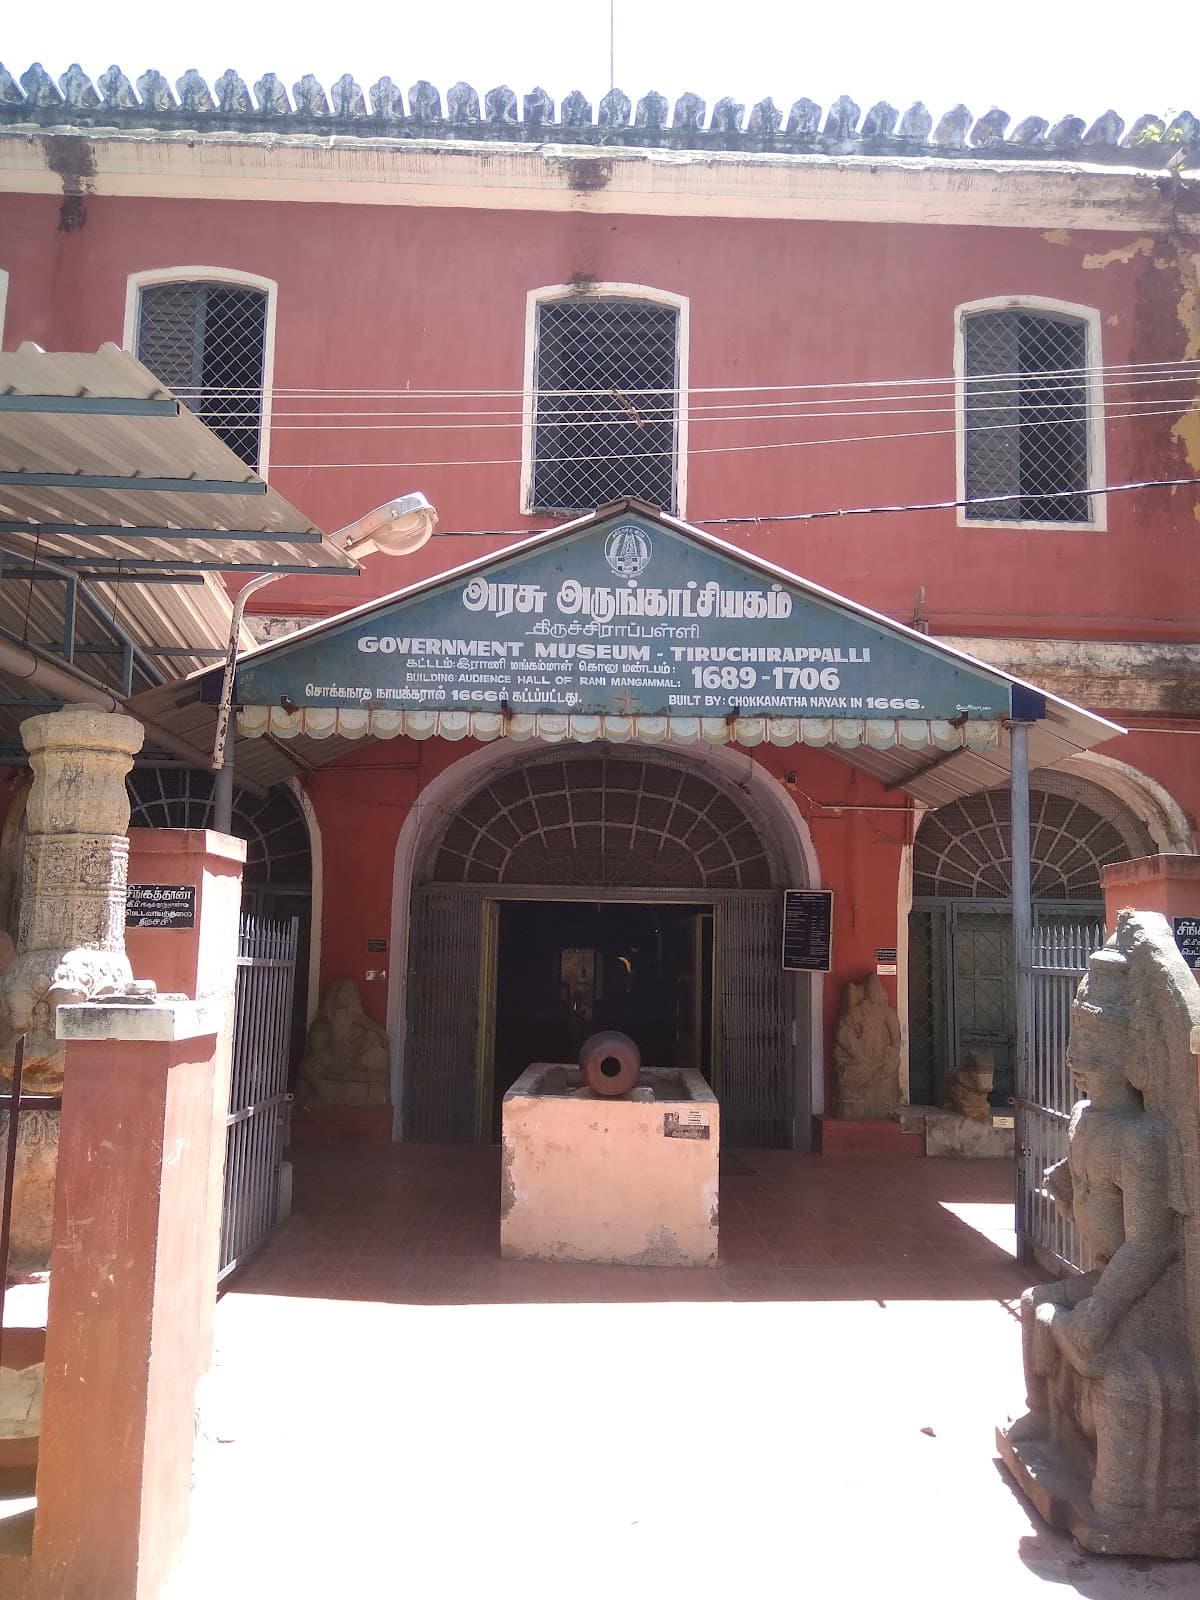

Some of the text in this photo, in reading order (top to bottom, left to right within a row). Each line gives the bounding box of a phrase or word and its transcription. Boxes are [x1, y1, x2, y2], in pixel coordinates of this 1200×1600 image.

[463, 576, 792, 623] அரசு அருங்காட்சியகம்
[525, 618, 700, 640] திருச்சிராப்பள்ளி
[357, 636, 524, 656] GOVERNMENT
[534, 642, 650, 662] MUSEUM
[670, 646, 871, 663] TIRUCHIRAPPALLI
[458, 674, 511, 683] AUDIENCE
[517, 675, 551, 685] HALL
[555, 676, 573, 685] OF
[580, 677, 606, 686] RANI
[611, 678, 681, 688] MANGAMMAL:
[691, 666, 757, 690] 1689
[772, 667, 840, 691] 1706
[668, 694, 700, 706] BUILT
[704, 695, 726, 707] BY:
[727, 695, 808, 708] CHOKKANATHA
[810, 696, 847, 709] NAYAK
[850, 697, 863, 709] IN
